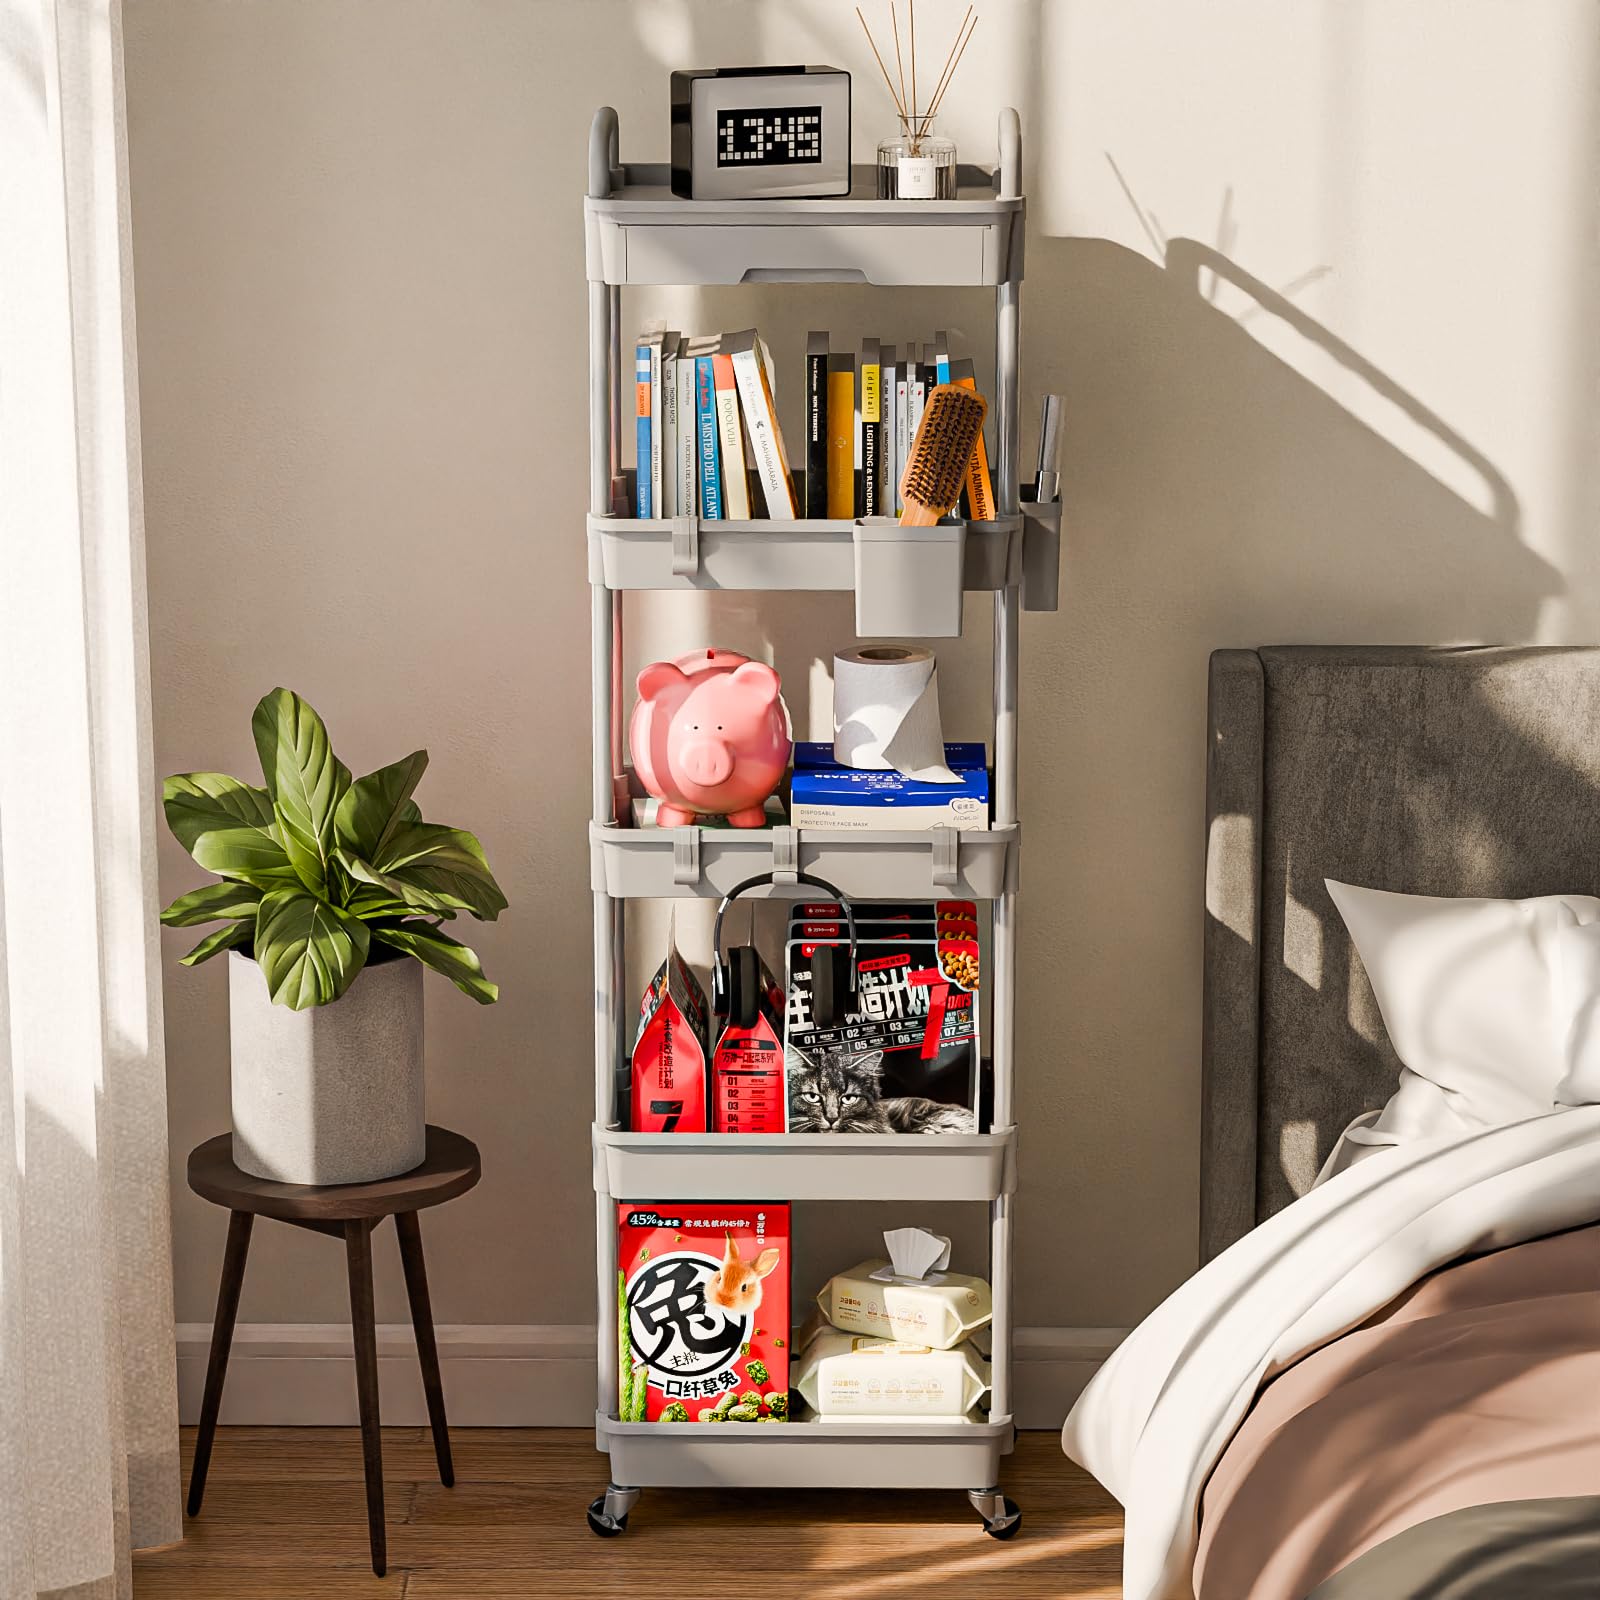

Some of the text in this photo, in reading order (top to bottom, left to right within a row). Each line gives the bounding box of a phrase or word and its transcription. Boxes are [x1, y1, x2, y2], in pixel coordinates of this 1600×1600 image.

[720, 117, 818, 160] 13:45
[701, 413, 712, 421] IL
[724, 398, 737, 446] POPOL VUH
[702, 421, 714, 460] MISTERO
[866, 424, 874, 467] LIGHTING
[907, 967, 973, 1059] 7 DAYS
[889, 1021, 903, 1032] 03
[943, 1026, 957, 1037] 07
[846, 1028, 860, 1039] 02
[897, 1034, 911, 1044] 06
[804, 1034, 816, 1045] 01
[854, 1040, 868, 1051] 05
[727, 1076, 739, 1086] 01
[727, 1088, 739, 1098] 02
[727, 1101, 739, 1111] 03
[727, 1113, 739, 1123] 04
[727, 1125, 739, 1133] 05
[629, 1213, 657, 1226] 45%
[633, 1261, 742, 1362] 兔
[647, 1369, 739, 1399] 一口纤草兔
